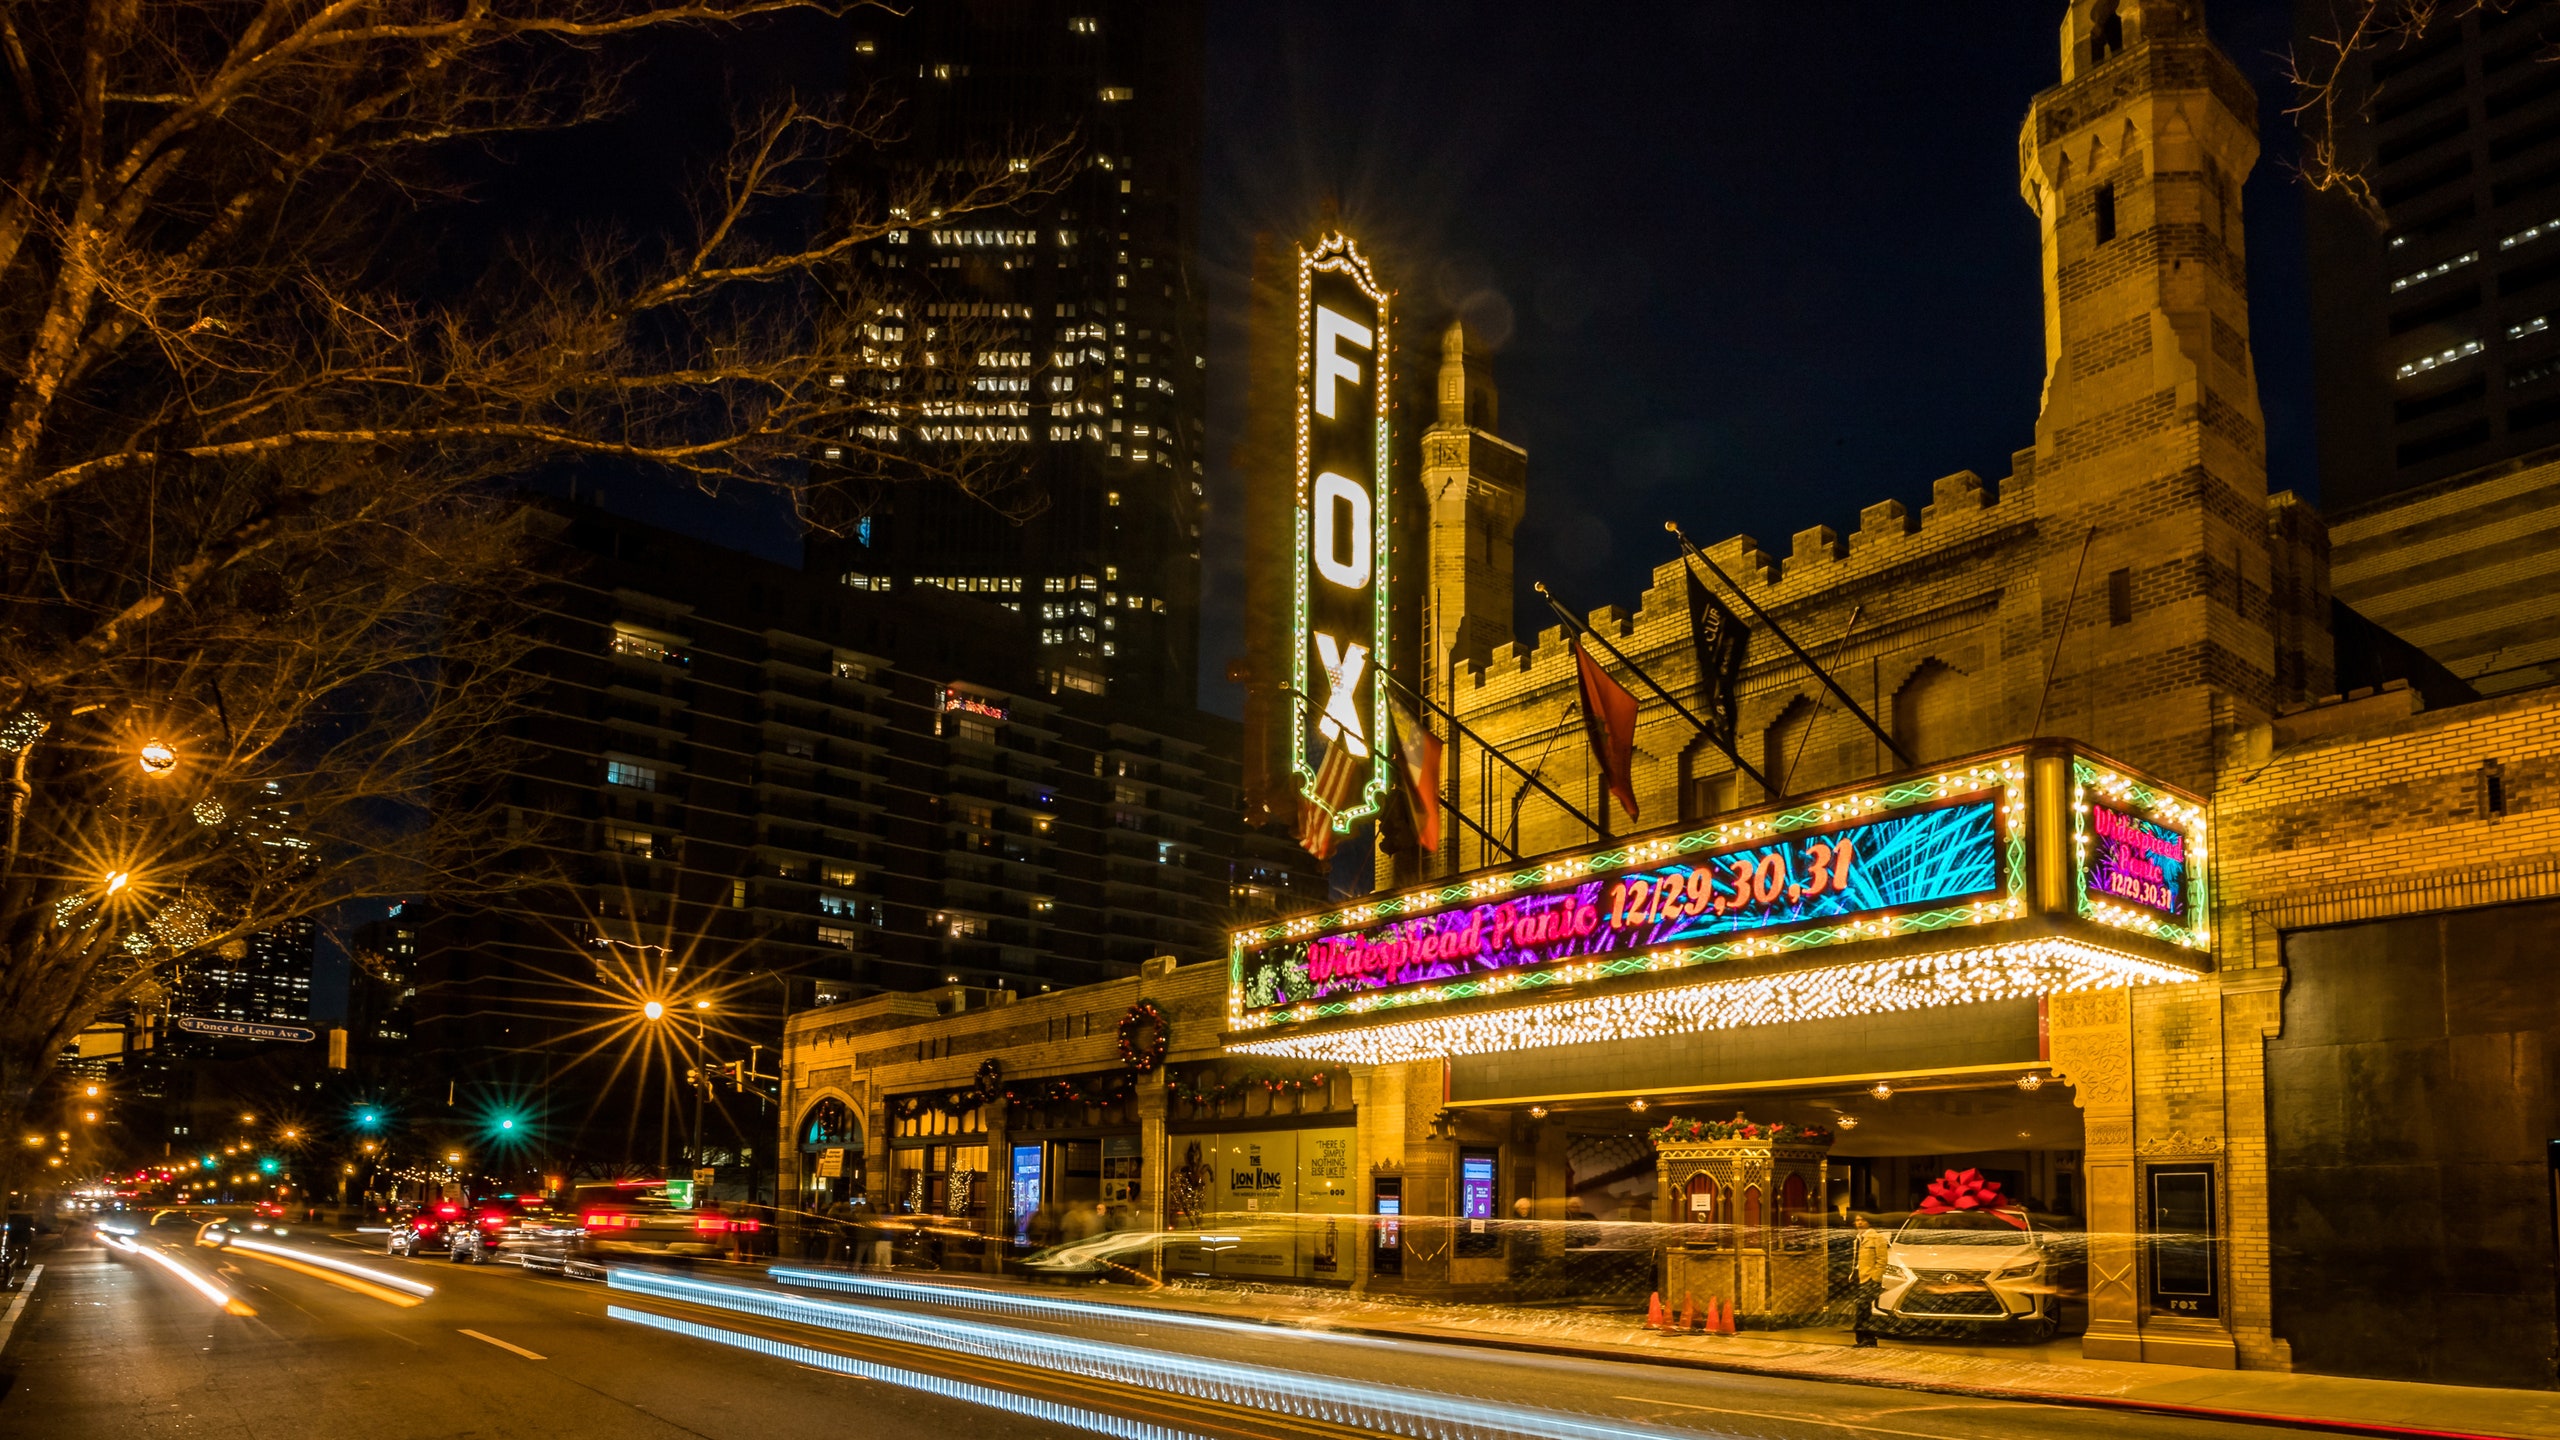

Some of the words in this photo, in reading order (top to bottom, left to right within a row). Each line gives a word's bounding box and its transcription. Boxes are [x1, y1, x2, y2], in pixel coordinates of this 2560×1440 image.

[1314, 304, 1374, 759] FOX
[2094, 804, 2184, 863] Widespread
[2119, 844, 2163, 883] Panic
[2111, 872, 2172, 909] 12/29,30,31
[1308, 910, 1483, 982] Widespread
[1492, 896, 1598, 950] Panic
[1610, 838, 1854, 929] 12/29,30,31
[196, 1021, 229, 1032] Ponce
[232, 1025, 246, 1034] de
[248, 1026, 275, 1036] Leon
[278, 1029, 299, 1039] Ave
[1340, 1140, 1346, 1149] IS
[1250, 1155, 1261, 1165] THE
[1323, 1149, 1346, 1158] SIMPLY
[1311, 1158, 1346, 1167] NOTHING
[1311, 1167, 1325, 1176] ELSE
[1326, 1167, 1338, 1176] LIKE
[2170, 1300, 2198, 1310] FOX
